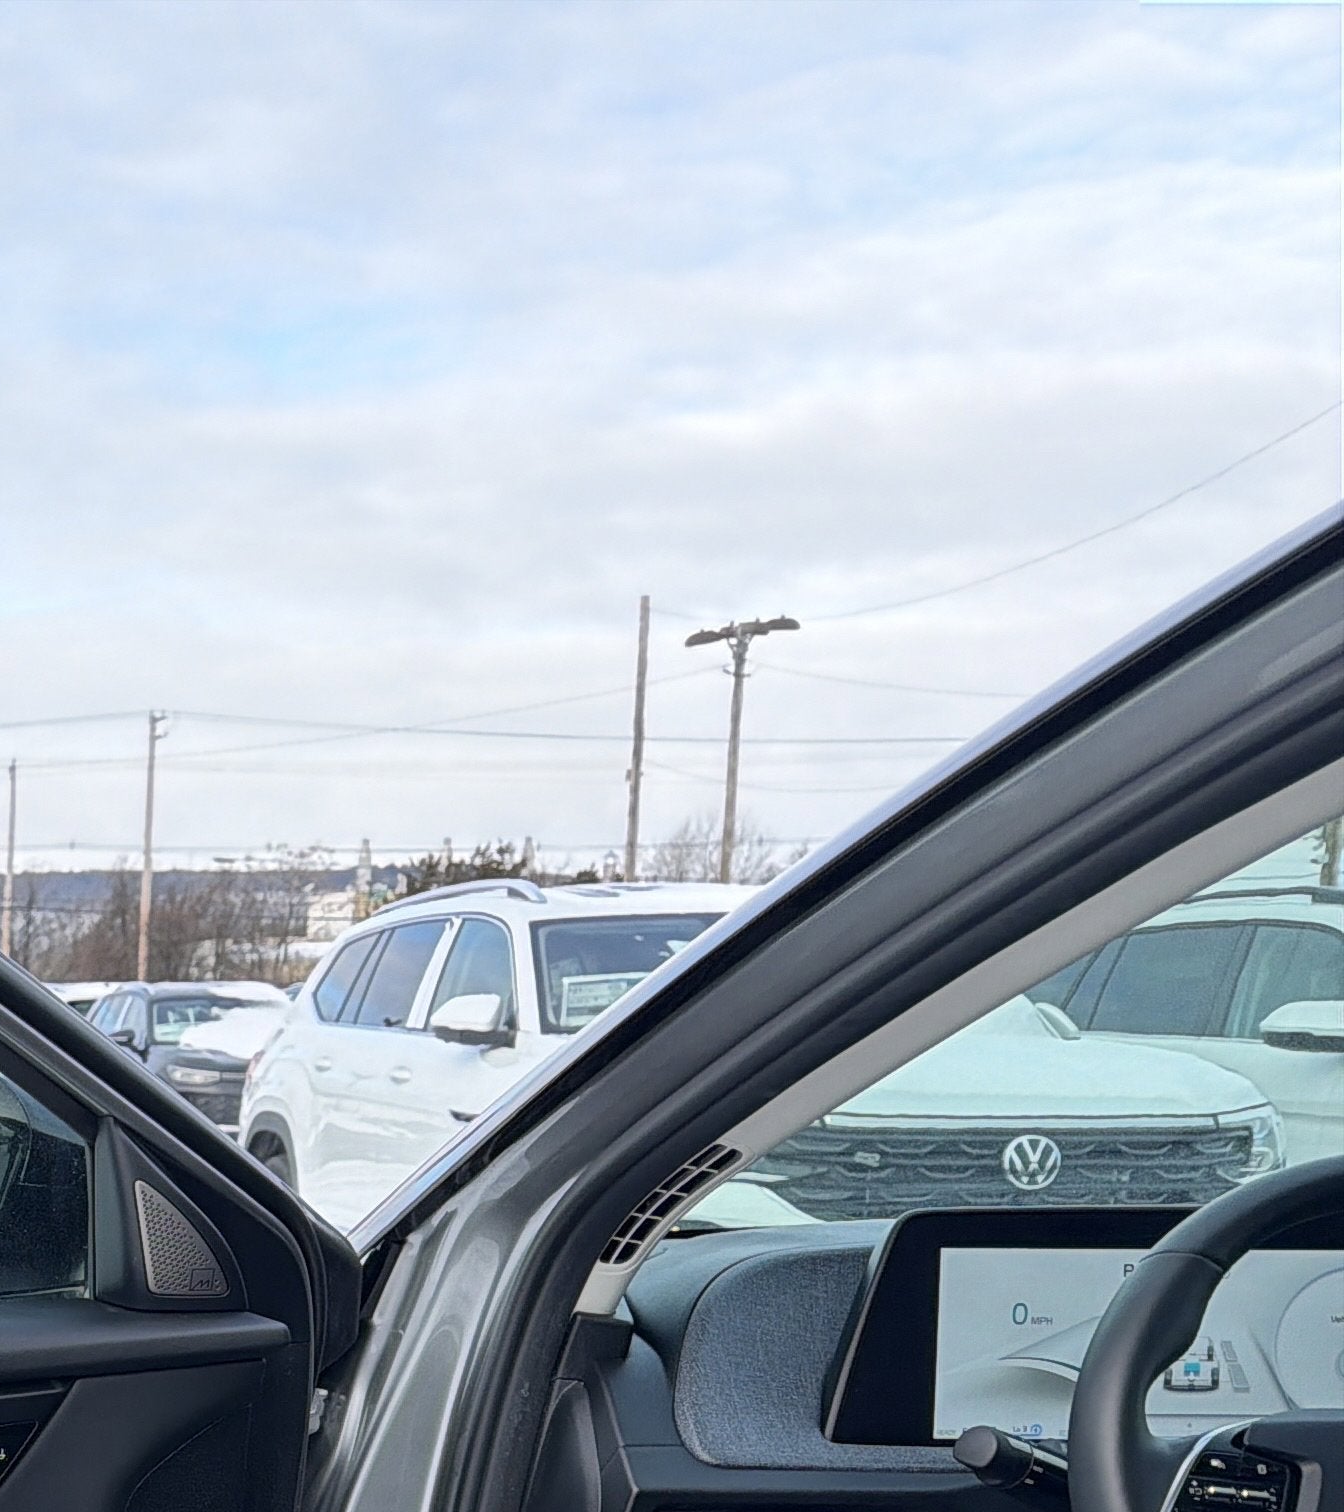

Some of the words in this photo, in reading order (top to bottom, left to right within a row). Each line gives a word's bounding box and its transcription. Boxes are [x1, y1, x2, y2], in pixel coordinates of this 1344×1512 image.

[1123, 1263, 1135, 1278] P
[1012, 1302, 1029, 1326] 0
[1031, 1316, 1054, 1326] MPH
